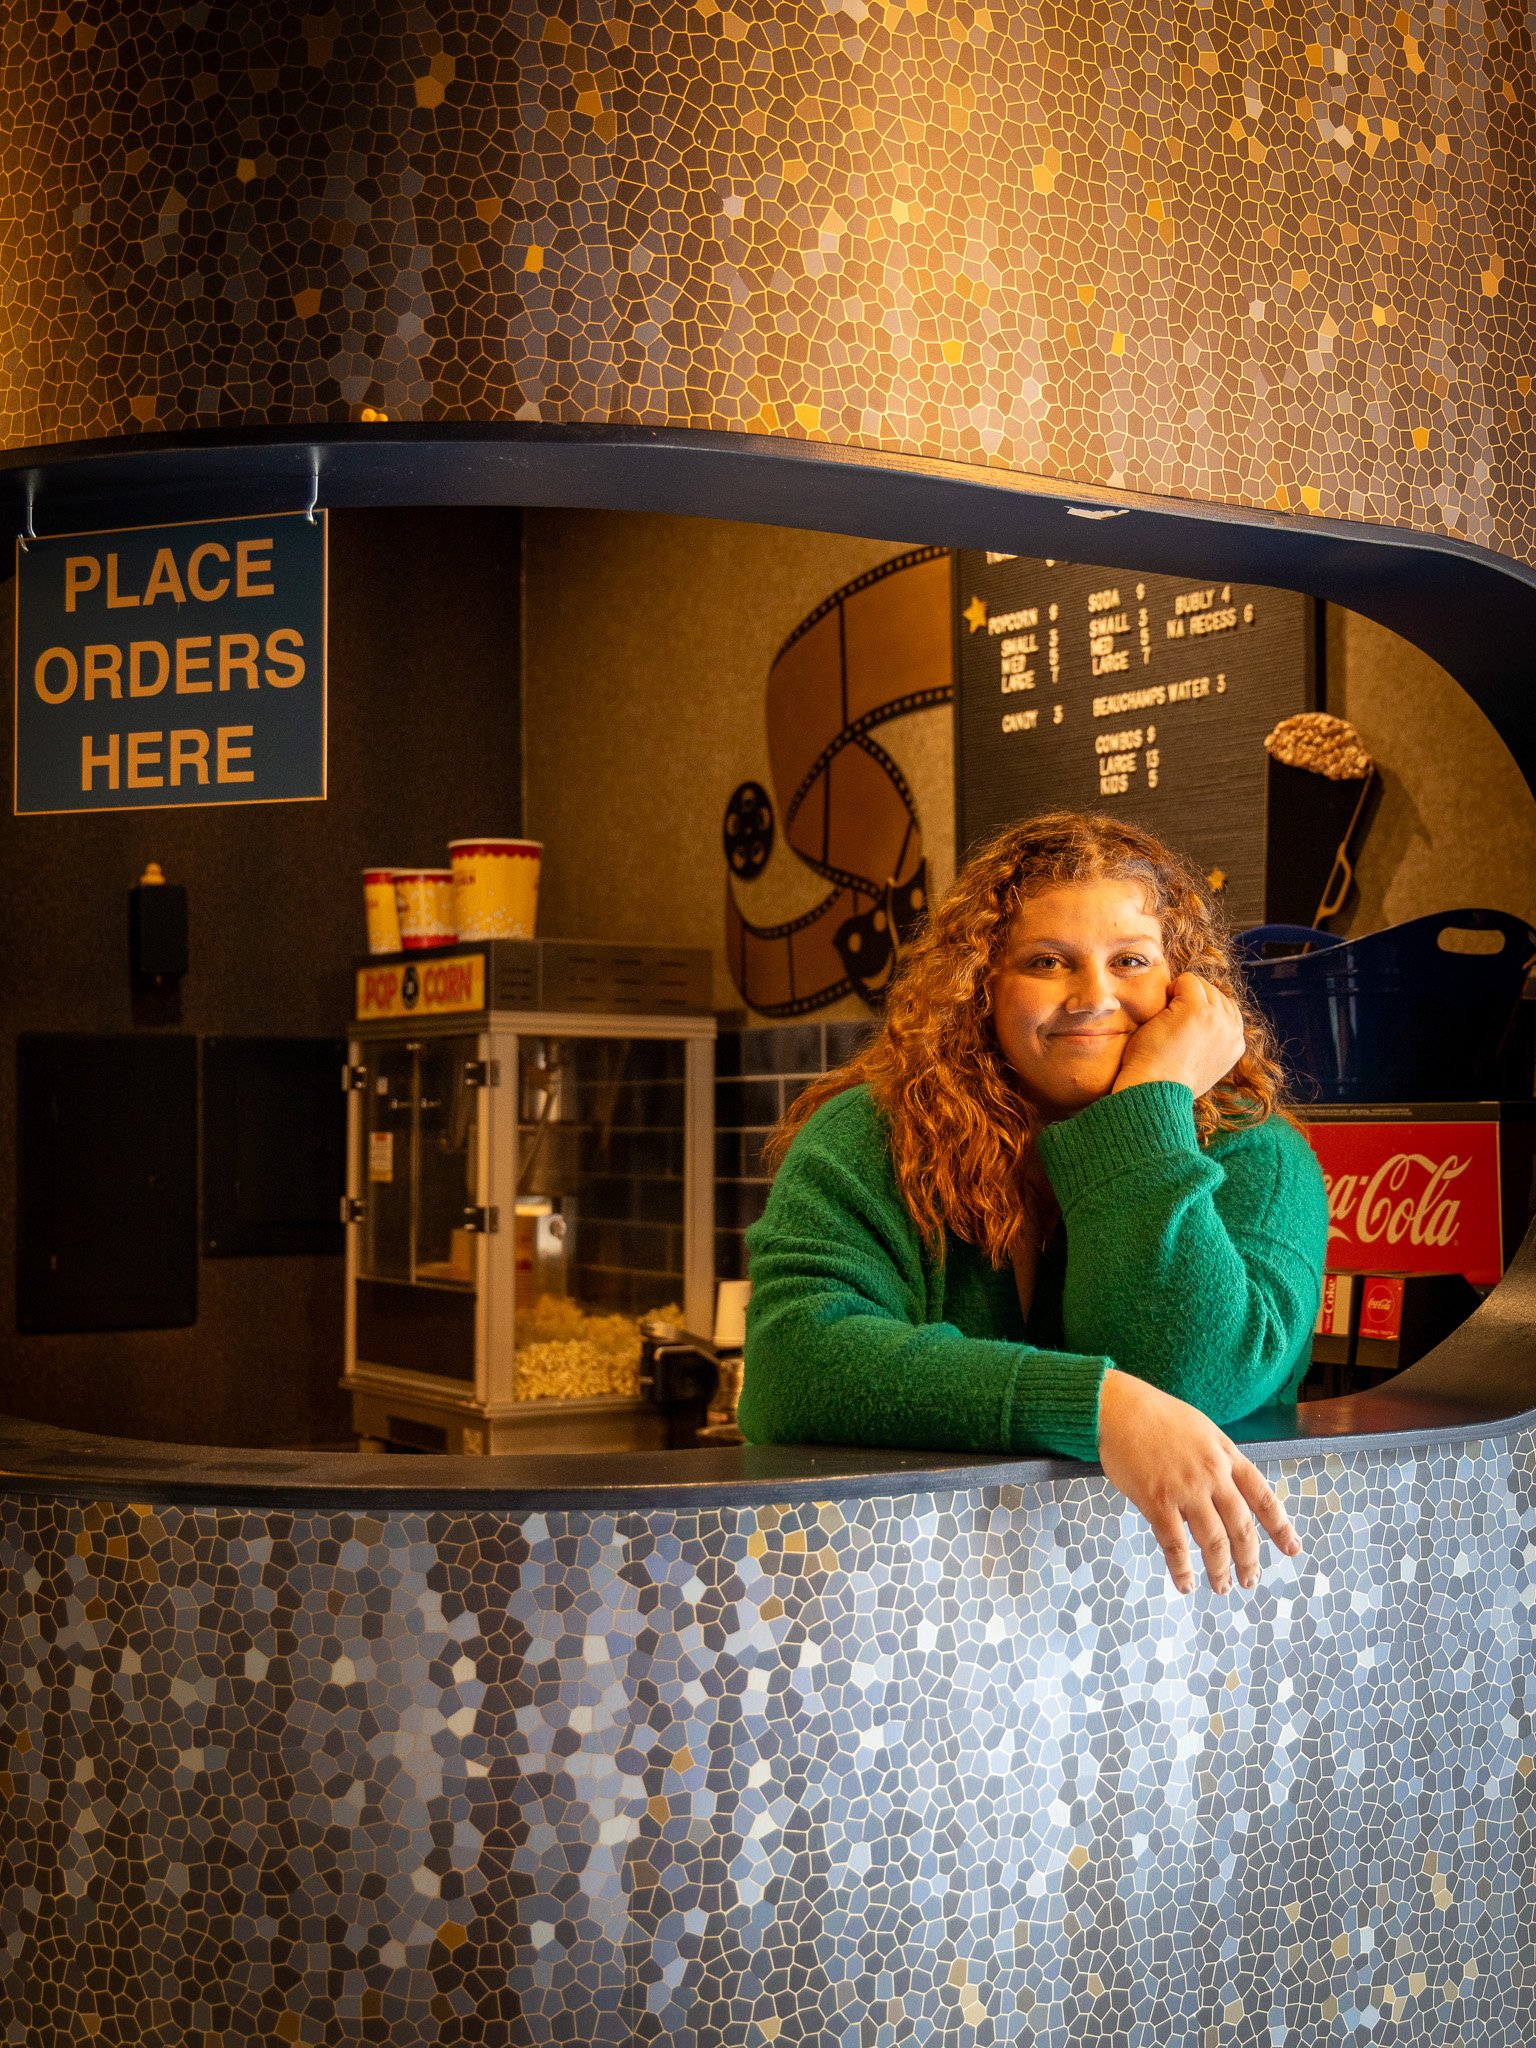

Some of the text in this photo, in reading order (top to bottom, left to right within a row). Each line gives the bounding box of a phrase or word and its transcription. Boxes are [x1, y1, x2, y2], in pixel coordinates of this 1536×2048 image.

[65, 538, 275, 613] PLACE
[1088, 588, 1121, 613] SODA
[1175, 584, 1231, 616] BUBLY 4
[988, 608, 1039, 636] POPCORN
[1089, 608, 1149, 638] SMALL 3
[1190, 607, 1237, 636] RECESS
[1244, 603, 1254, 624] 6
[1001, 628, 1060, 658] SMALL 3
[1090, 627, 1150, 657] MED 5
[34, 628, 306, 705] ORDERS
[1001, 653, 1027, 675] MED
[1091, 646, 1152, 677] LARGE 7
[1001, 665, 1061, 694] LARGE 7
[1092, 673, 1227, 718] BEAUCHAMPS WATER 3
[1002, 704, 1064, 733] CANDY 3
[1095, 729, 1144, 755] COMBOS
[81, 725, 255, 791] HERE
[1099, 752, 1138, 777] LARGE
[1100, 768, 1159, 796] KIDS 5
[364, 962, 473, 1010] POP CORN
[1323, 1278, 1337, 1314] Coke
